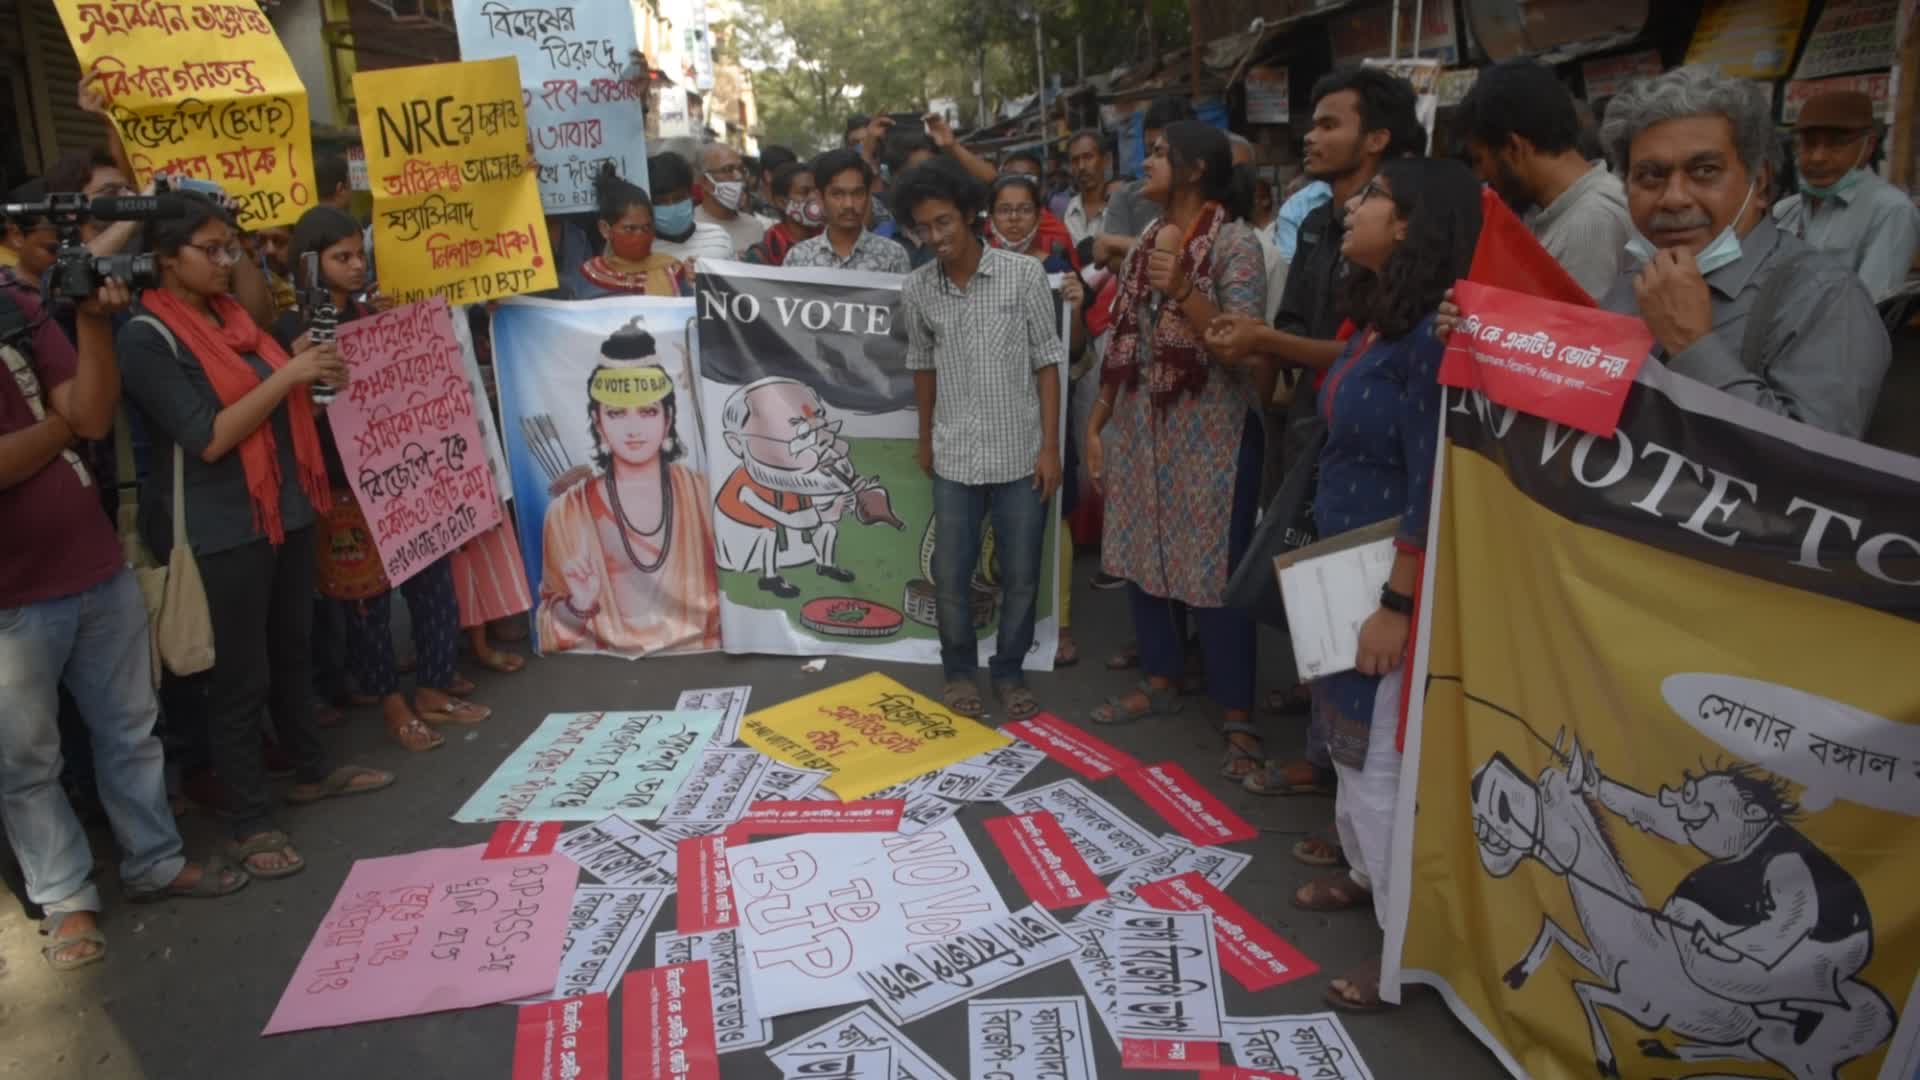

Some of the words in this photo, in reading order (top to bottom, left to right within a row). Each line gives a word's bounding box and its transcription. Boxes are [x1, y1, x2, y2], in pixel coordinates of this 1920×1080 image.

[470, 275, 492, 297] TO
[495, 268, 537, 293] BJP
[701, 290, 760, 323] NO
[774, 296, 891, 336] VOTE
[1558, 345, 1601, 369] ভোট
[1601, 354, 1629, 379] নয়
[605, 378, 631, 393] VOTE
[634, 378, 649, 393] TO
[1785, 496, 1920, 587] TO
[1699, 694, 1796, 752] সোনার
[1808, 733, 1900, 783] বঙ্গাল
[732, 849, 854, 979] BJP
